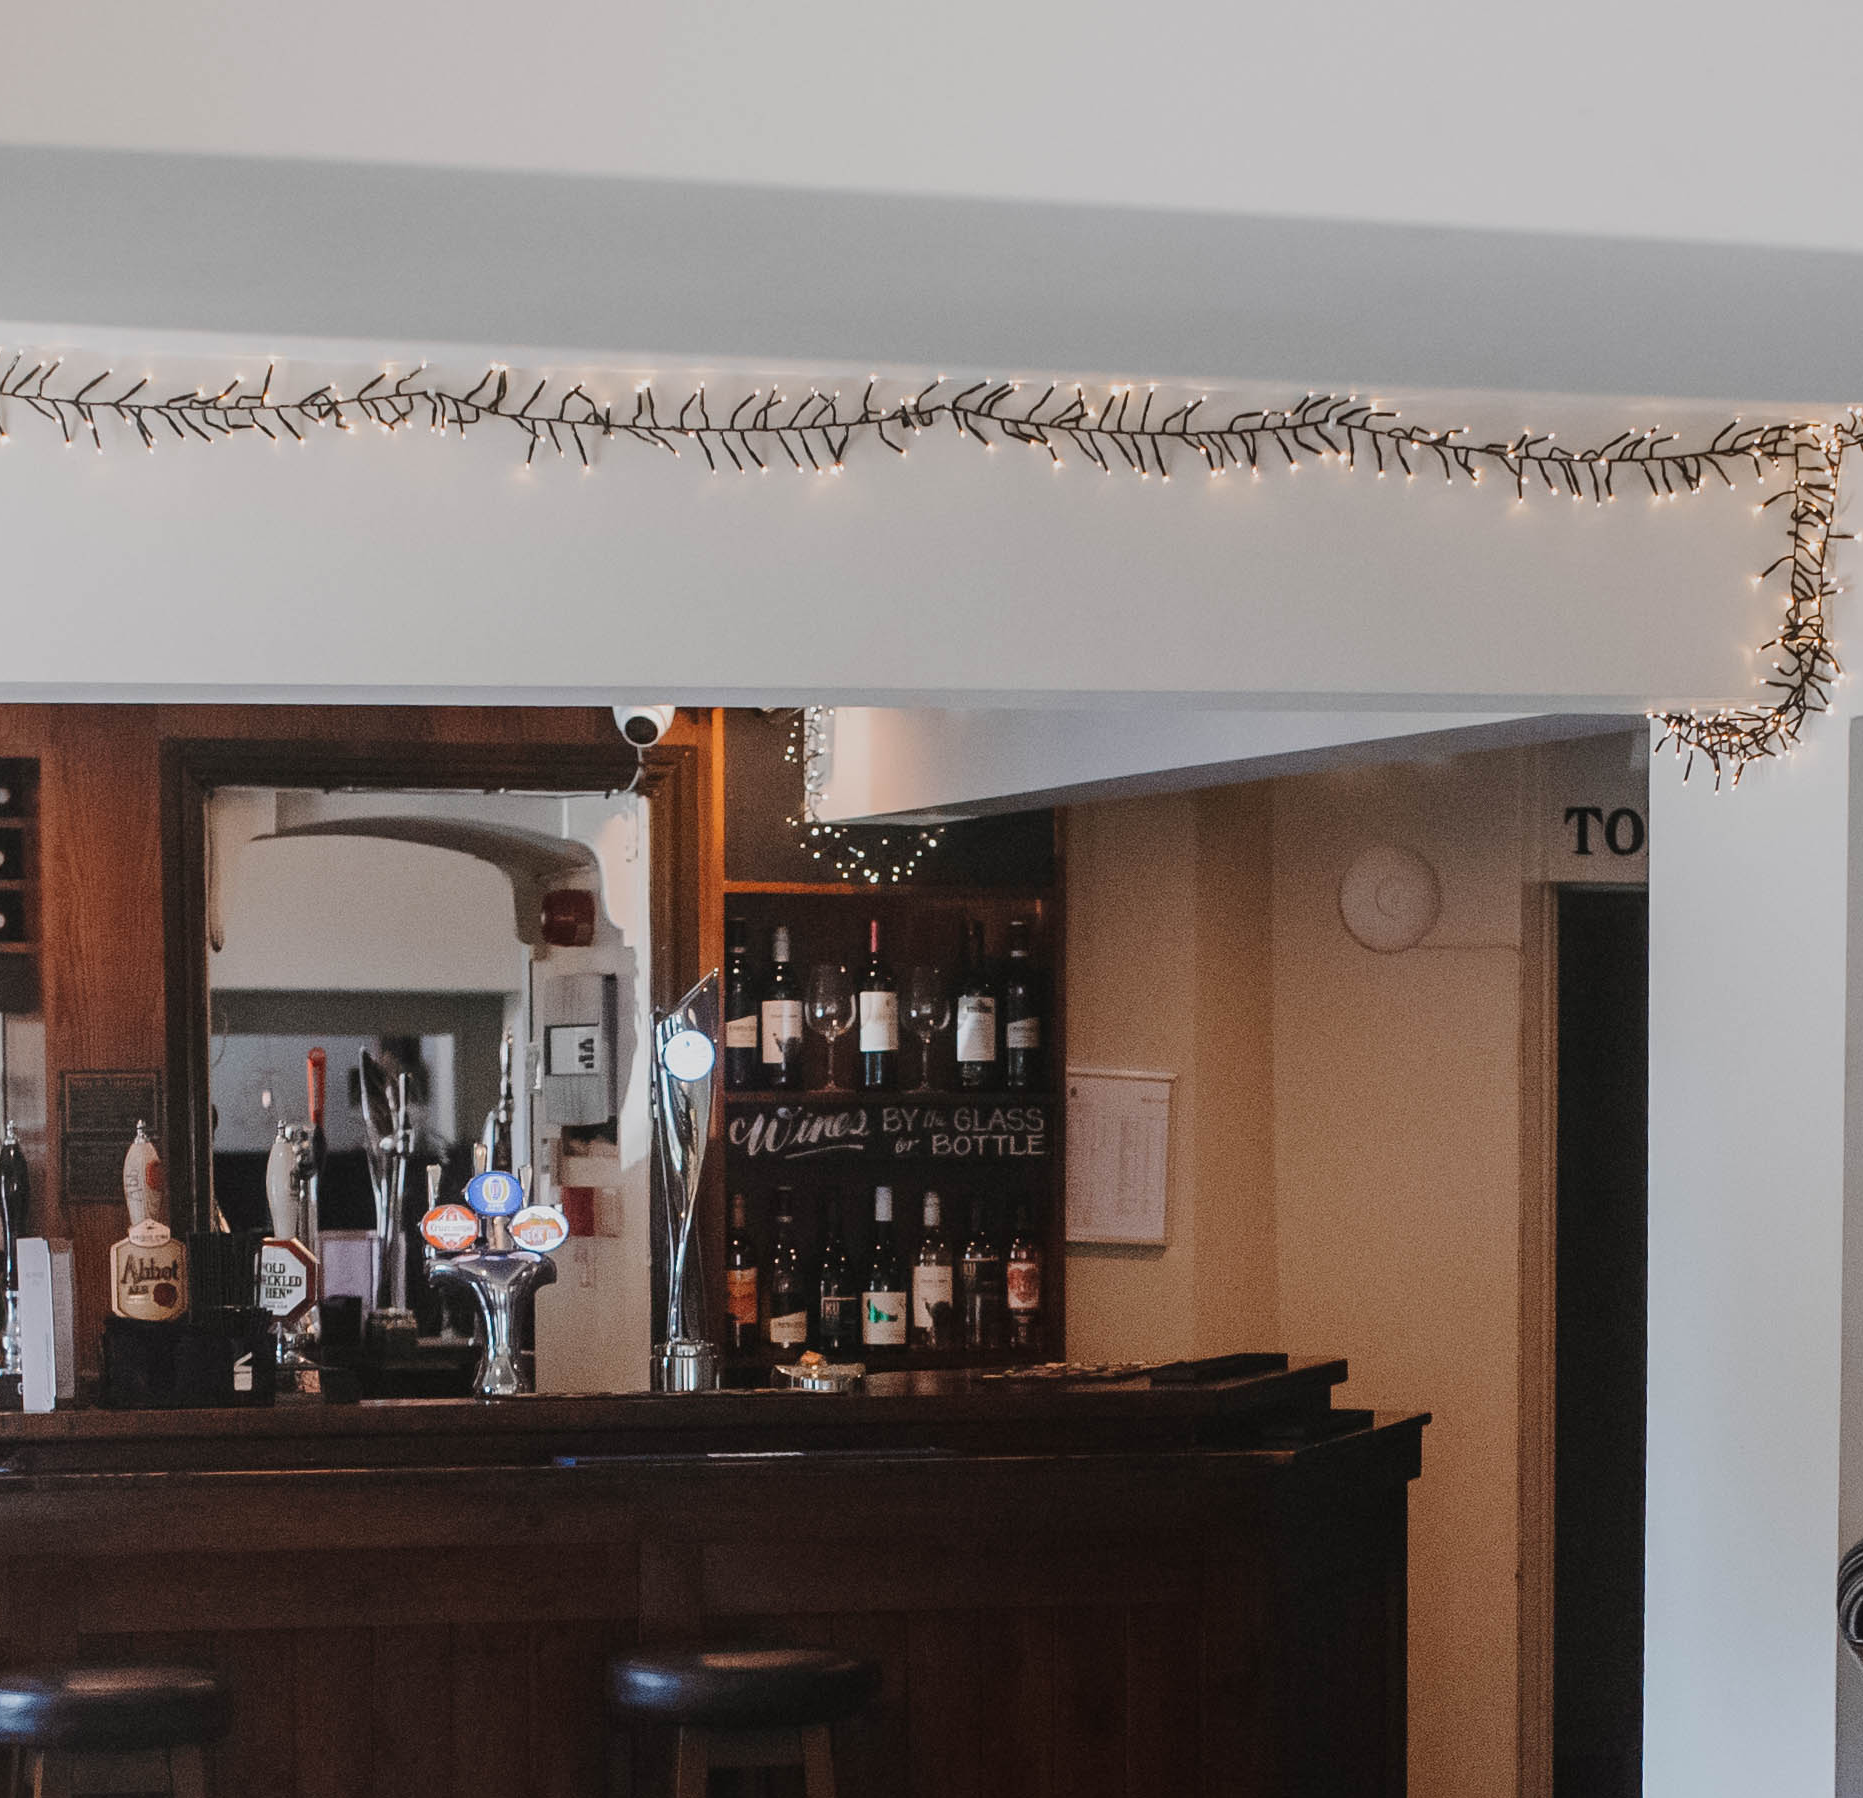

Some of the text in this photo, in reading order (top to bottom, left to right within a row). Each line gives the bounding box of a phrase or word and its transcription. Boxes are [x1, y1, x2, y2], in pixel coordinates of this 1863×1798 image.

[1564, 807, 1645, 856] TO
[728, 1106, 871, 1156] Wines
[882, 1107, 919, 1132] BY
[953, 1107, 1045, 1132] GLASS
[894, 1134, 1045, 1156] or BOTTLE
[120, 1254, 179, 1284] Abbot
